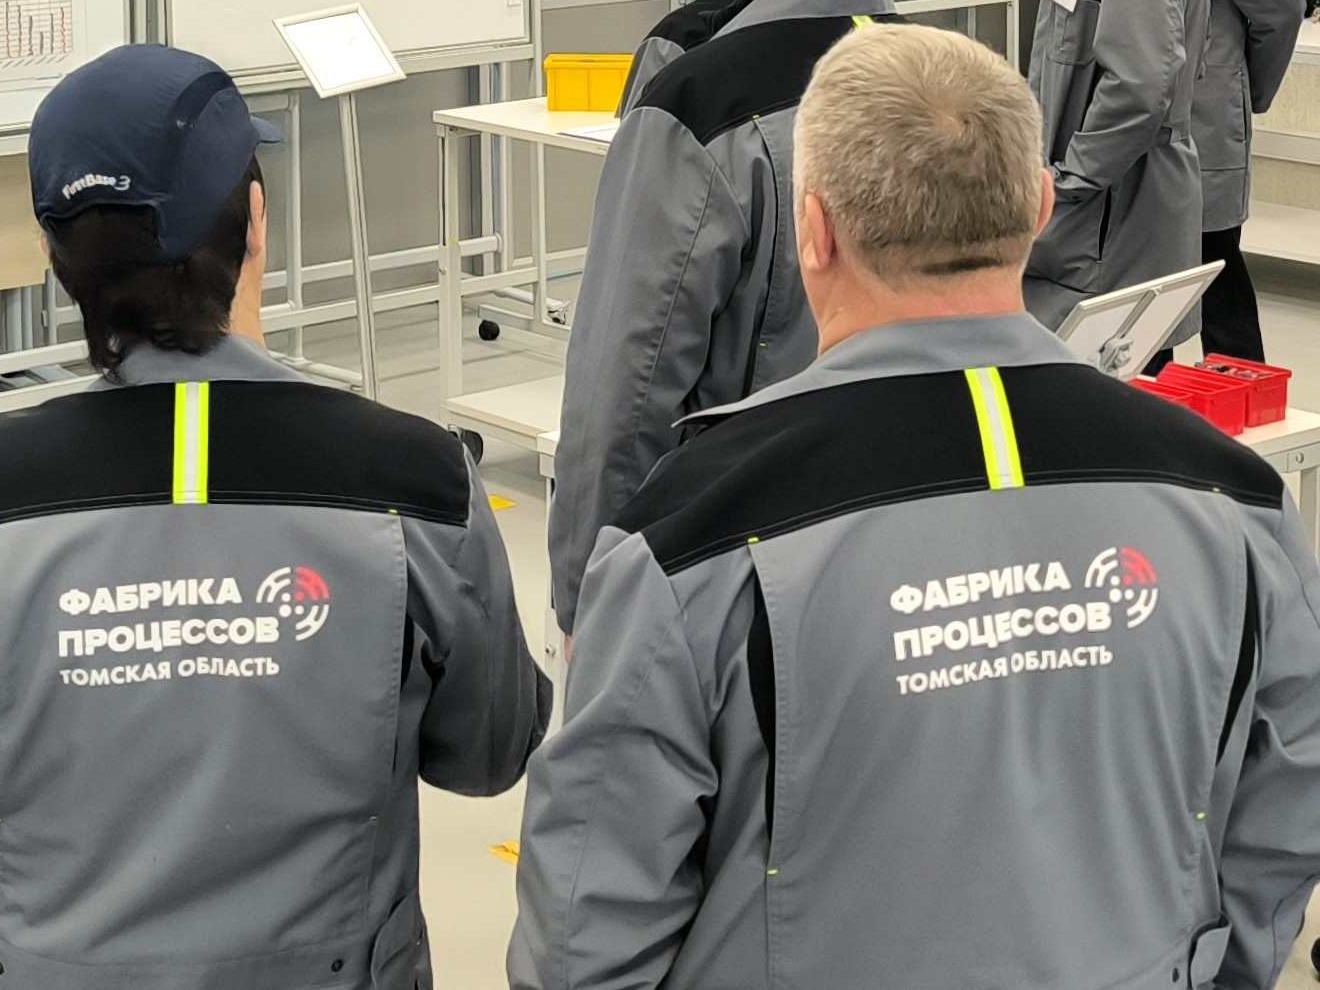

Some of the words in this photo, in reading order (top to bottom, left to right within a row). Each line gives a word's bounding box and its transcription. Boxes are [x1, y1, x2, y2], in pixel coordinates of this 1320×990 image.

[59, 577, 243, 616] ФАБРИКА
[890, 560, 1072, 614] ФАБРИКА
[58, 616, 280, 658] ПРОЦЕССОВ
[893, 601, 1112, 661] ПРОЦЕССОВ
[59, 661, 171, 687] ТОМСКАЯ
[178, 656, 280, 677] ОБЛАСТЬ
[896, 657, 1009, 696] ТОМСКАЯ
[1010, 645, 1114, 674] ОБЛАСТЬ
